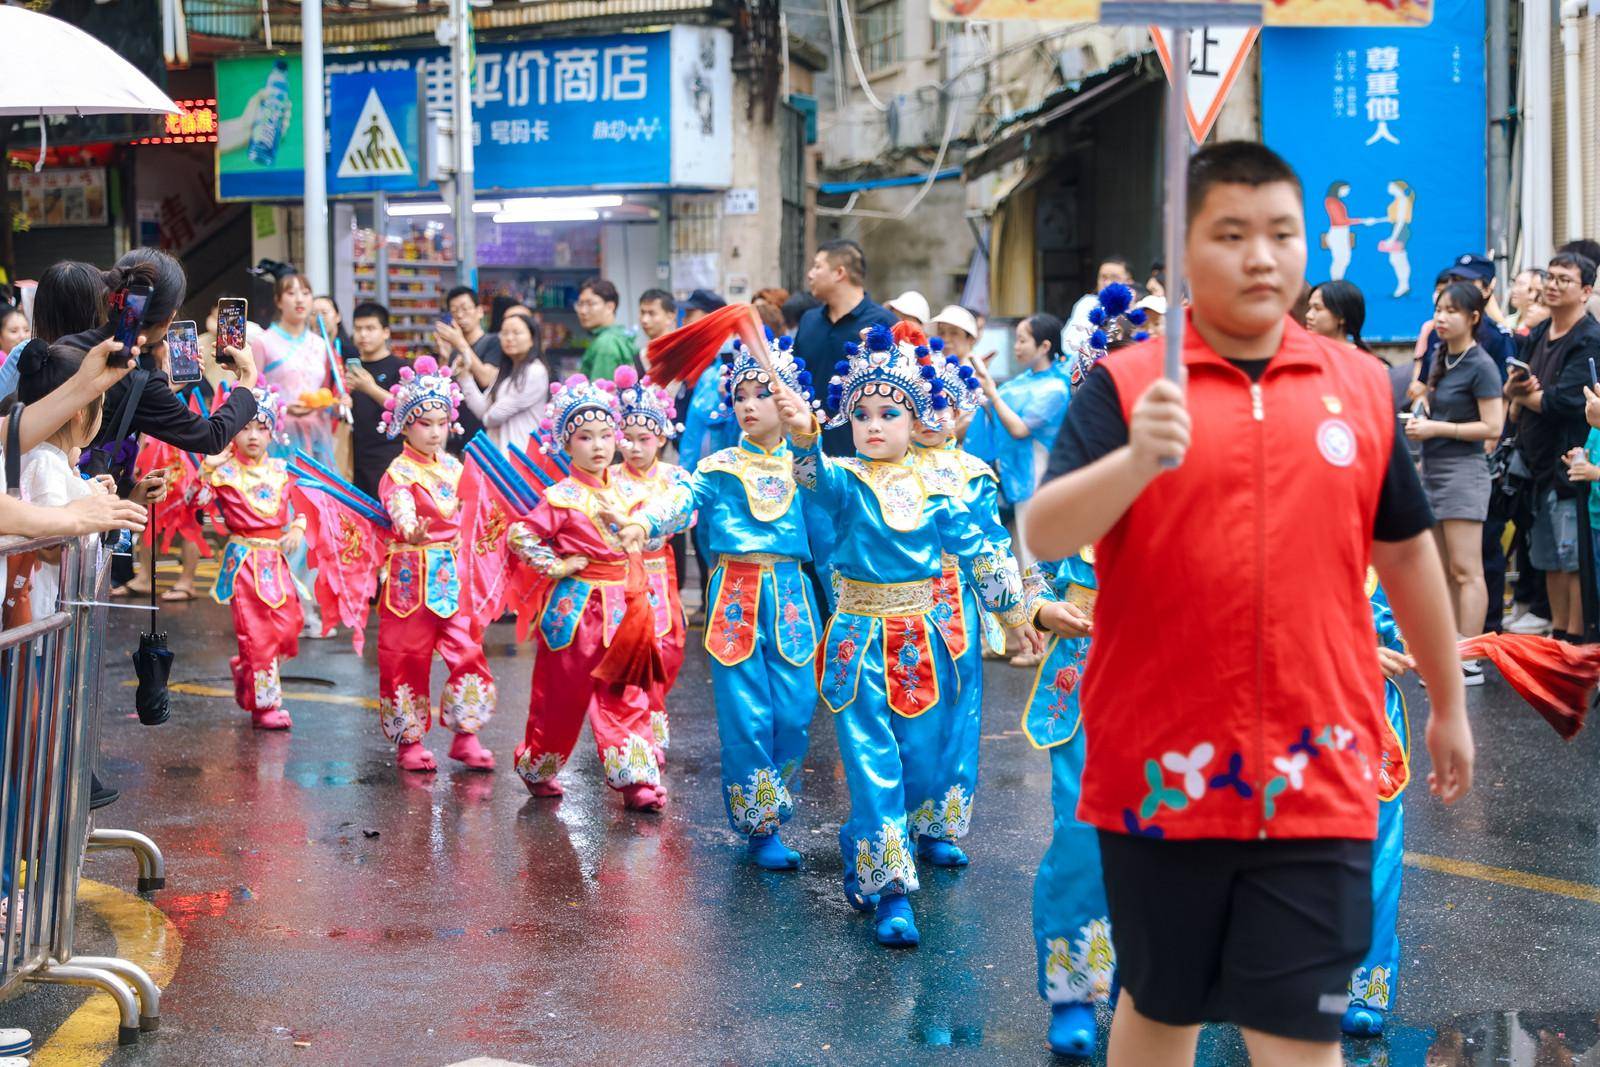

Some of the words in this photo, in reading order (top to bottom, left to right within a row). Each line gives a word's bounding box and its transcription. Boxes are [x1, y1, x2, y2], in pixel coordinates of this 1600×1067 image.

[325, 45, 649, 109] 佳平价商店
[1364, 46, 1400, 146] 尊重他人
